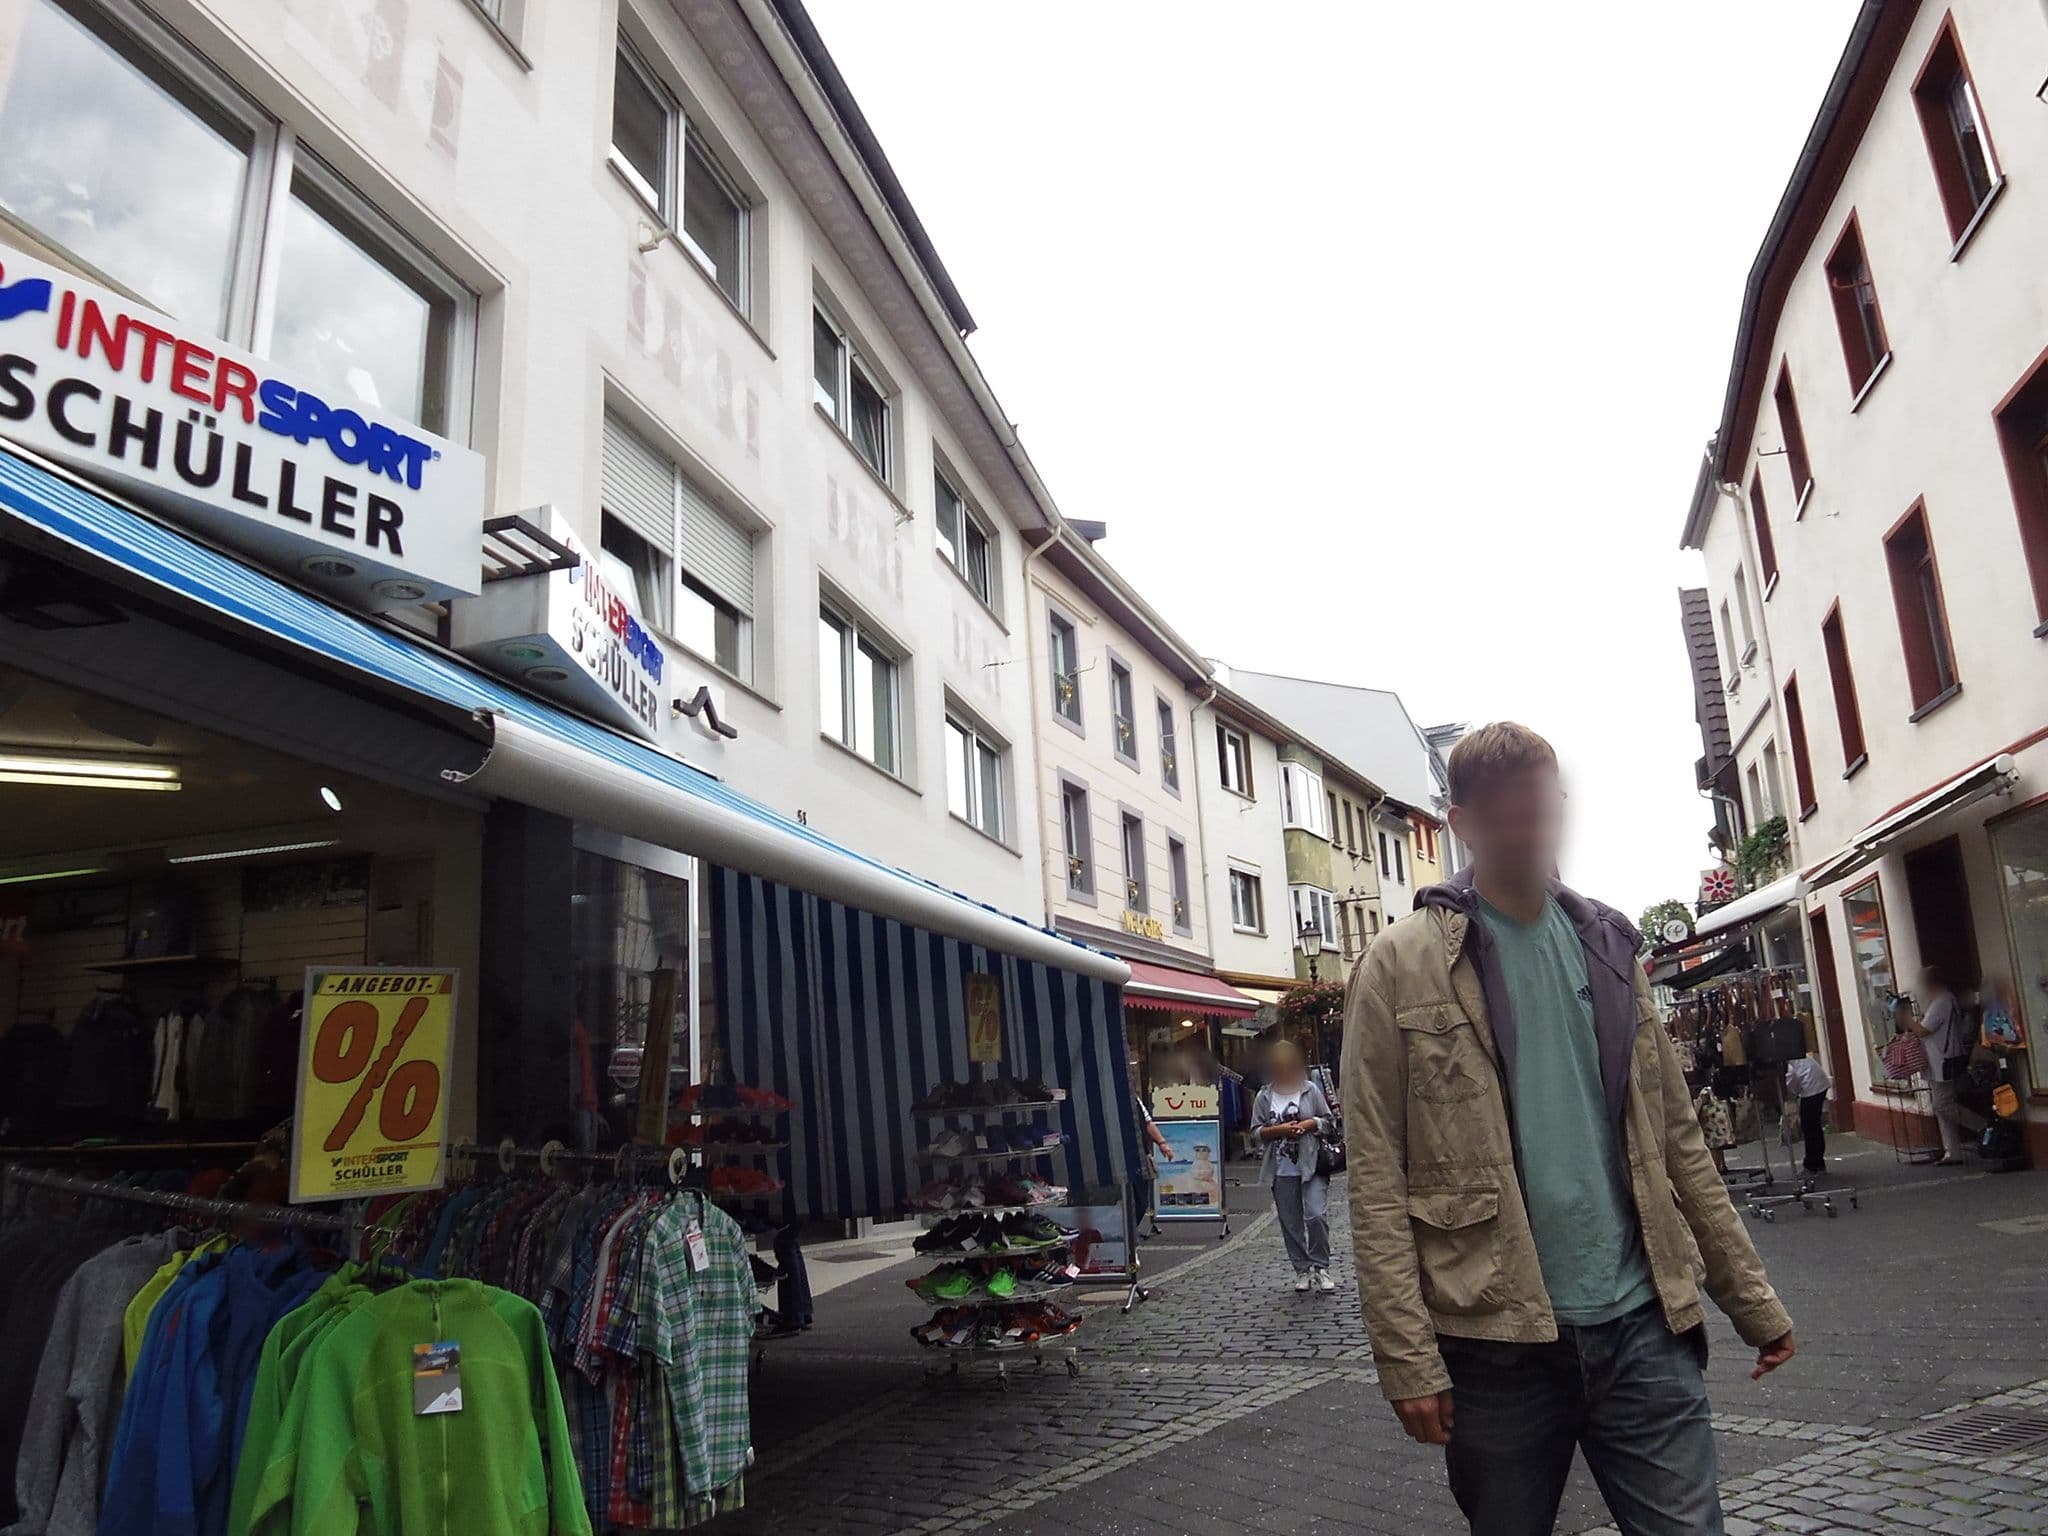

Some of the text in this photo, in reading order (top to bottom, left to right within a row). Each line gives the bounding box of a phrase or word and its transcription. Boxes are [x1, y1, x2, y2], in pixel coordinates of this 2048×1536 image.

[56, 290, 432, 491] INTERSPORT
[0, 354, 404, 557] SCHÜLLER
[572, 607, 658, 732] SCHÜLLER
[585, 560, 664, 686] INTERSPORT
[343, 1151, 409, 1167] INTERSPORT
[1190, 1099, 1207, 1109] TUI
[335, 1164, 404, 1181] SCHÜLLER
